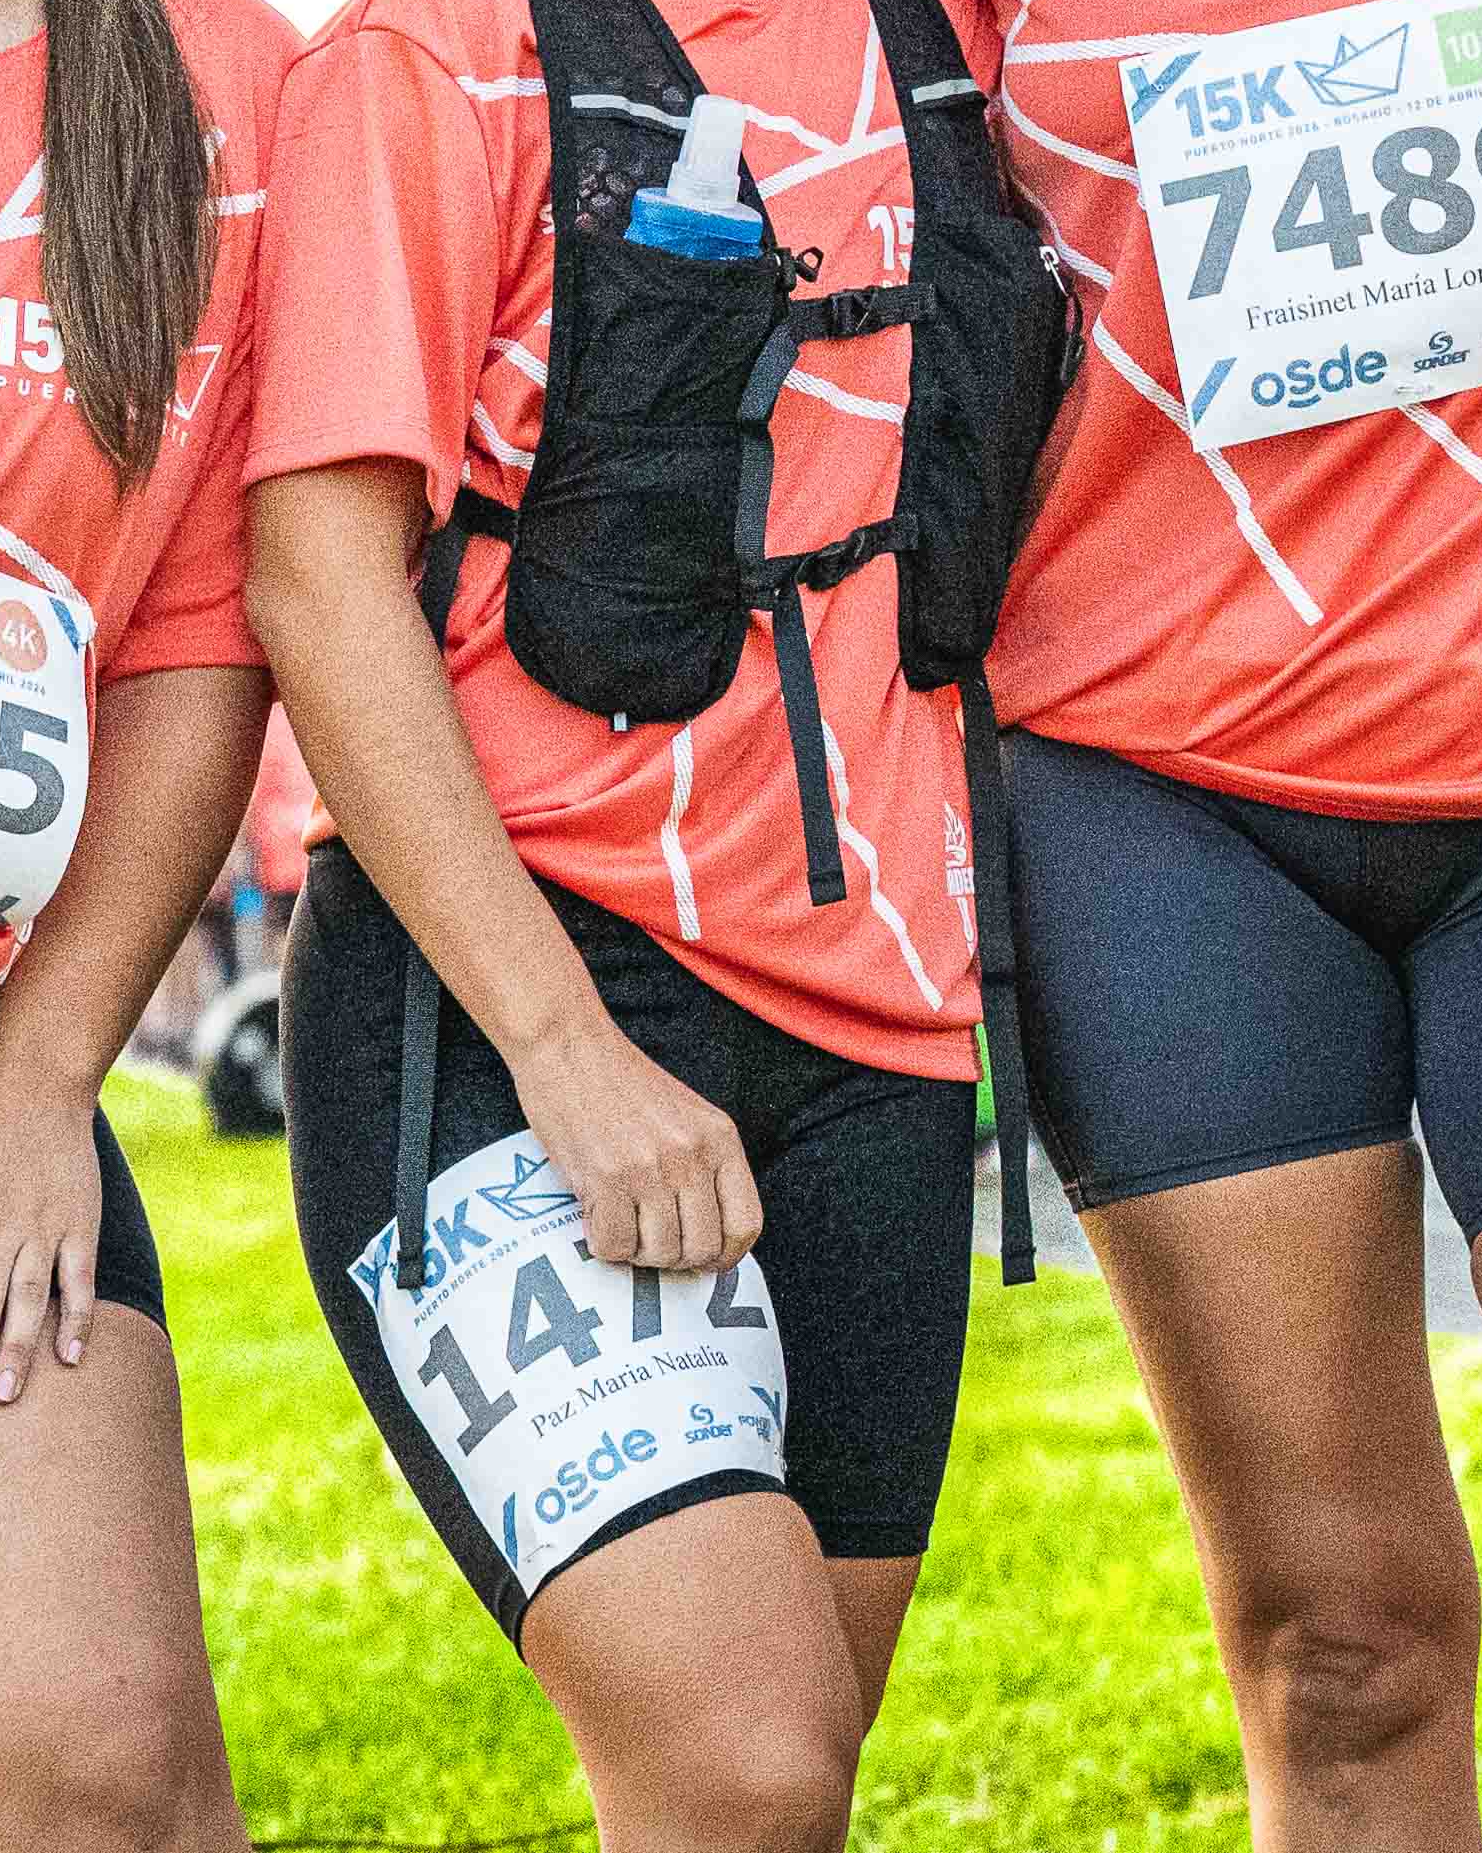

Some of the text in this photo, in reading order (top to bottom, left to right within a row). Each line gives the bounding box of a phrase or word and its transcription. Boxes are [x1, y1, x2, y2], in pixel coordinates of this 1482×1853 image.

[1175, 64, 1297, 138] 15K
[866, 204, 915, 270] 15
[1246, 291, 1356, 331] Fraisinet
[1251, 343, 1388, 406] osde
[1, 623, 39, 657] 4K
[414, 1289, 450, 1326] PUERTO
[450, 1260, 487, 1292] NORTE
[491, 1240, 520, 1262] 2026
[530, 1345, 730, 1438] Paz Maria Natalia
[535, 1429, 658, 1524] osde
